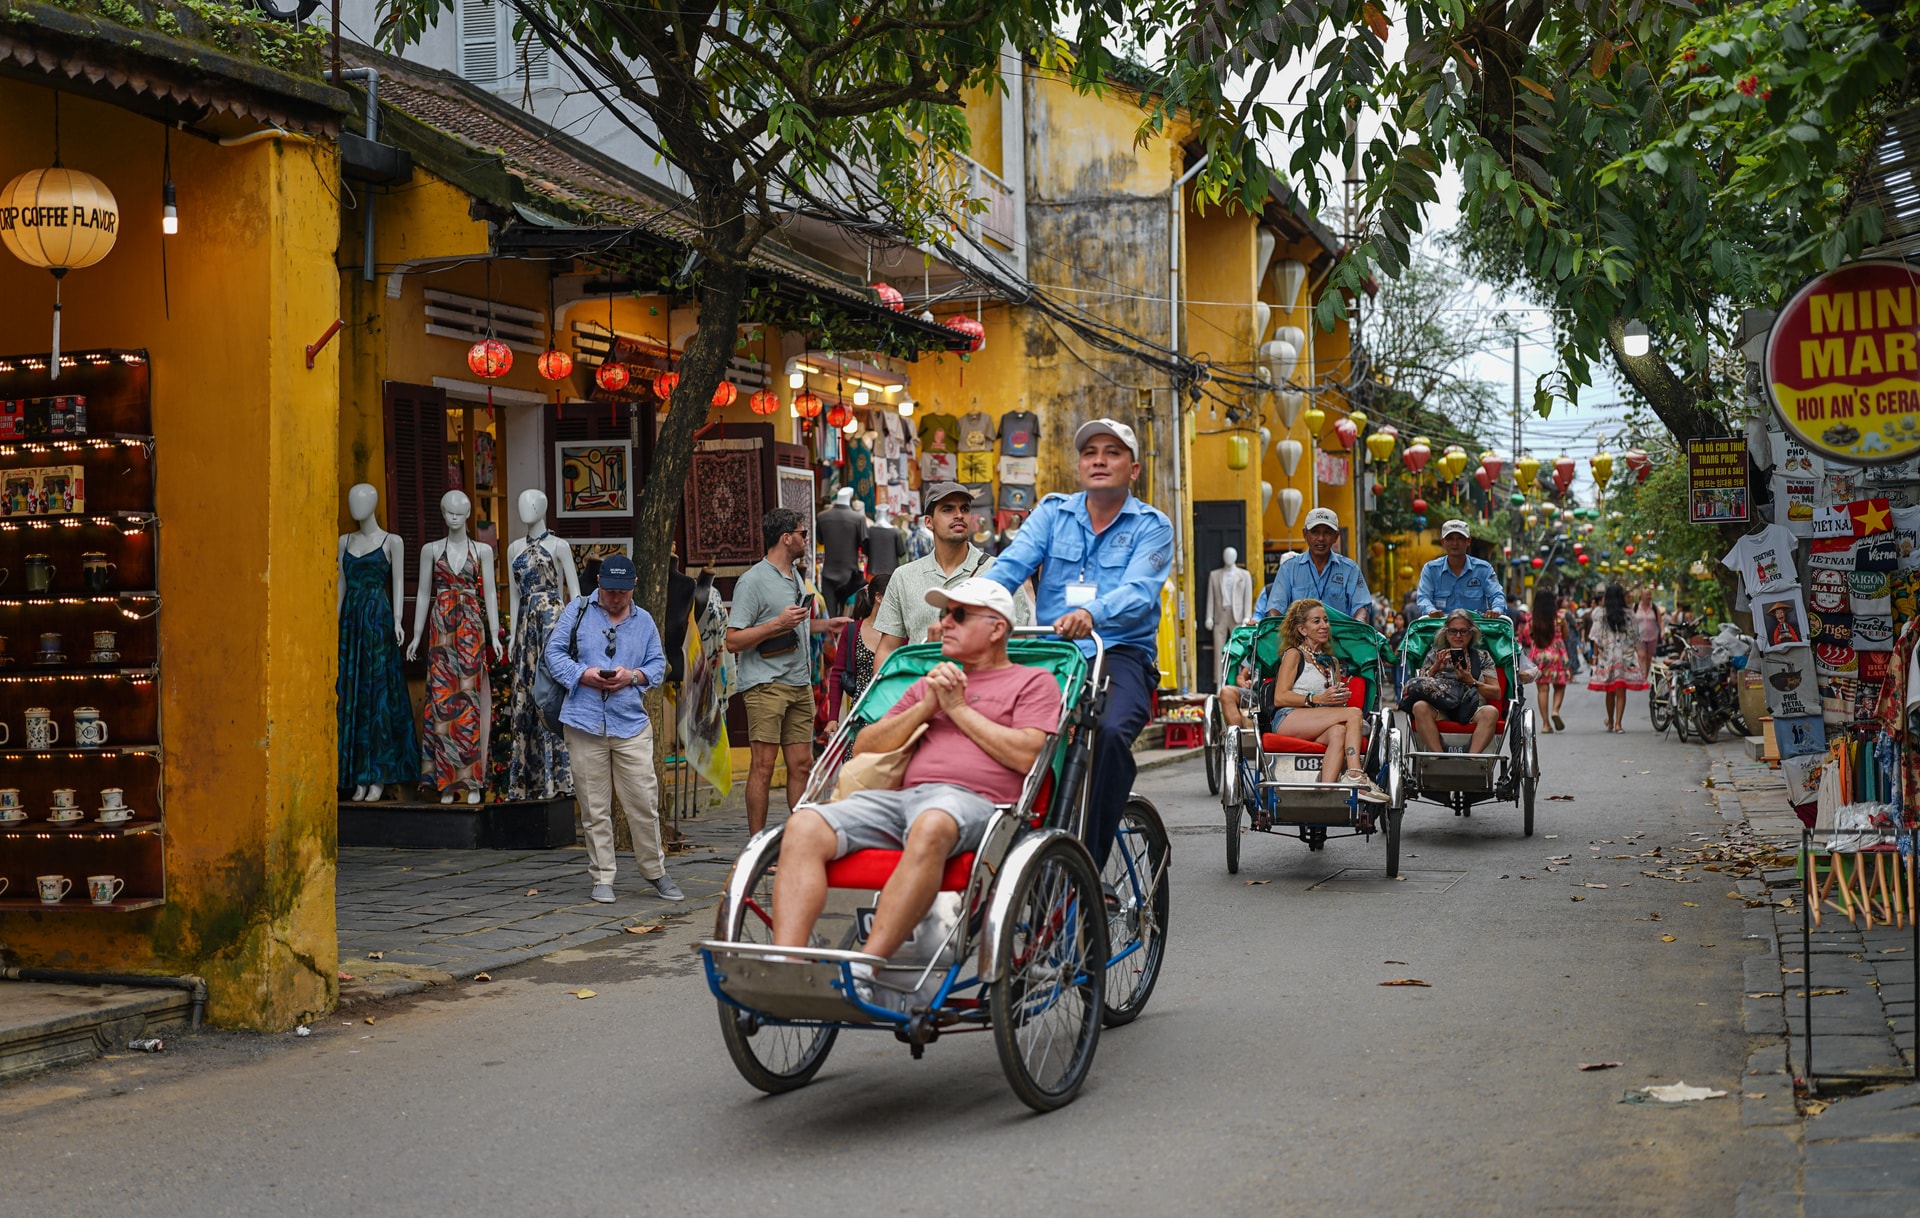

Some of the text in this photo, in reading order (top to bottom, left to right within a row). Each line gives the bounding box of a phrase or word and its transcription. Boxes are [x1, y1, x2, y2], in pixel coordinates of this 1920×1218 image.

[21, 206, 68, 227] COFFEE
[73, 205, 116, 233] FLAVOR
[1800, 332, 1920, 379] MAR
[1796, 396, 1825, 421] HOI
[1830, 387, 1871, 419] AN'S
[1699, 454, 1719, 464] TRANG
[1732, 466, 1744, 475] SALE
[1826, 507, 1830, 515] I
[1834, 519, 1852, 531] NA
[1753, 549, 1775, 562] TOGETHER
[1770, 573, 1782, 581] EVER
[1781, 701, 1803, 709] METAL
[1782, 707, 1806, 715] JACKET
[1296, 757, 1323, 770] 08
